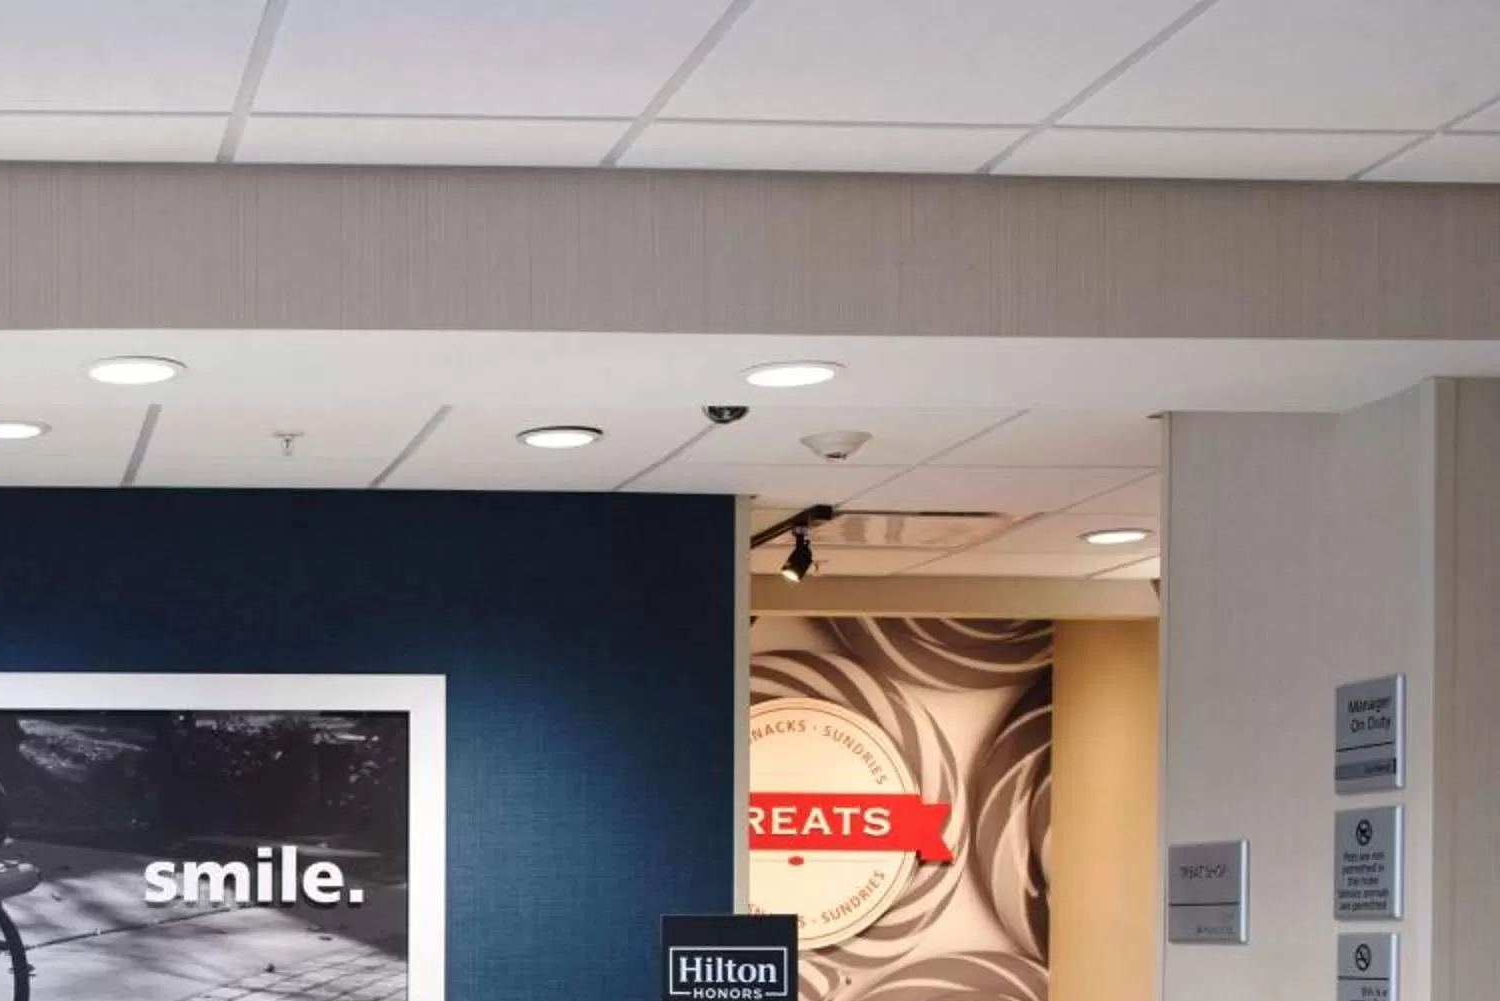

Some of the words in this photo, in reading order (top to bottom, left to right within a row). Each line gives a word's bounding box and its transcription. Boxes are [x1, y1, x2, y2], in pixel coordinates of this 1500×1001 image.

[1367, 714, 1391, 731] Duty
[749, 719, 806, 743] NACKS
[822, 725, 887, 785] SUNDRIES
[748, 806, 891, 836] REATS
[144, 845, 364, 904] smile.
[821, 869, 885, 924] SUNDRIES
[678, 956, 777, 983] Hilton
[693, 987, 762, 999] HONORS
